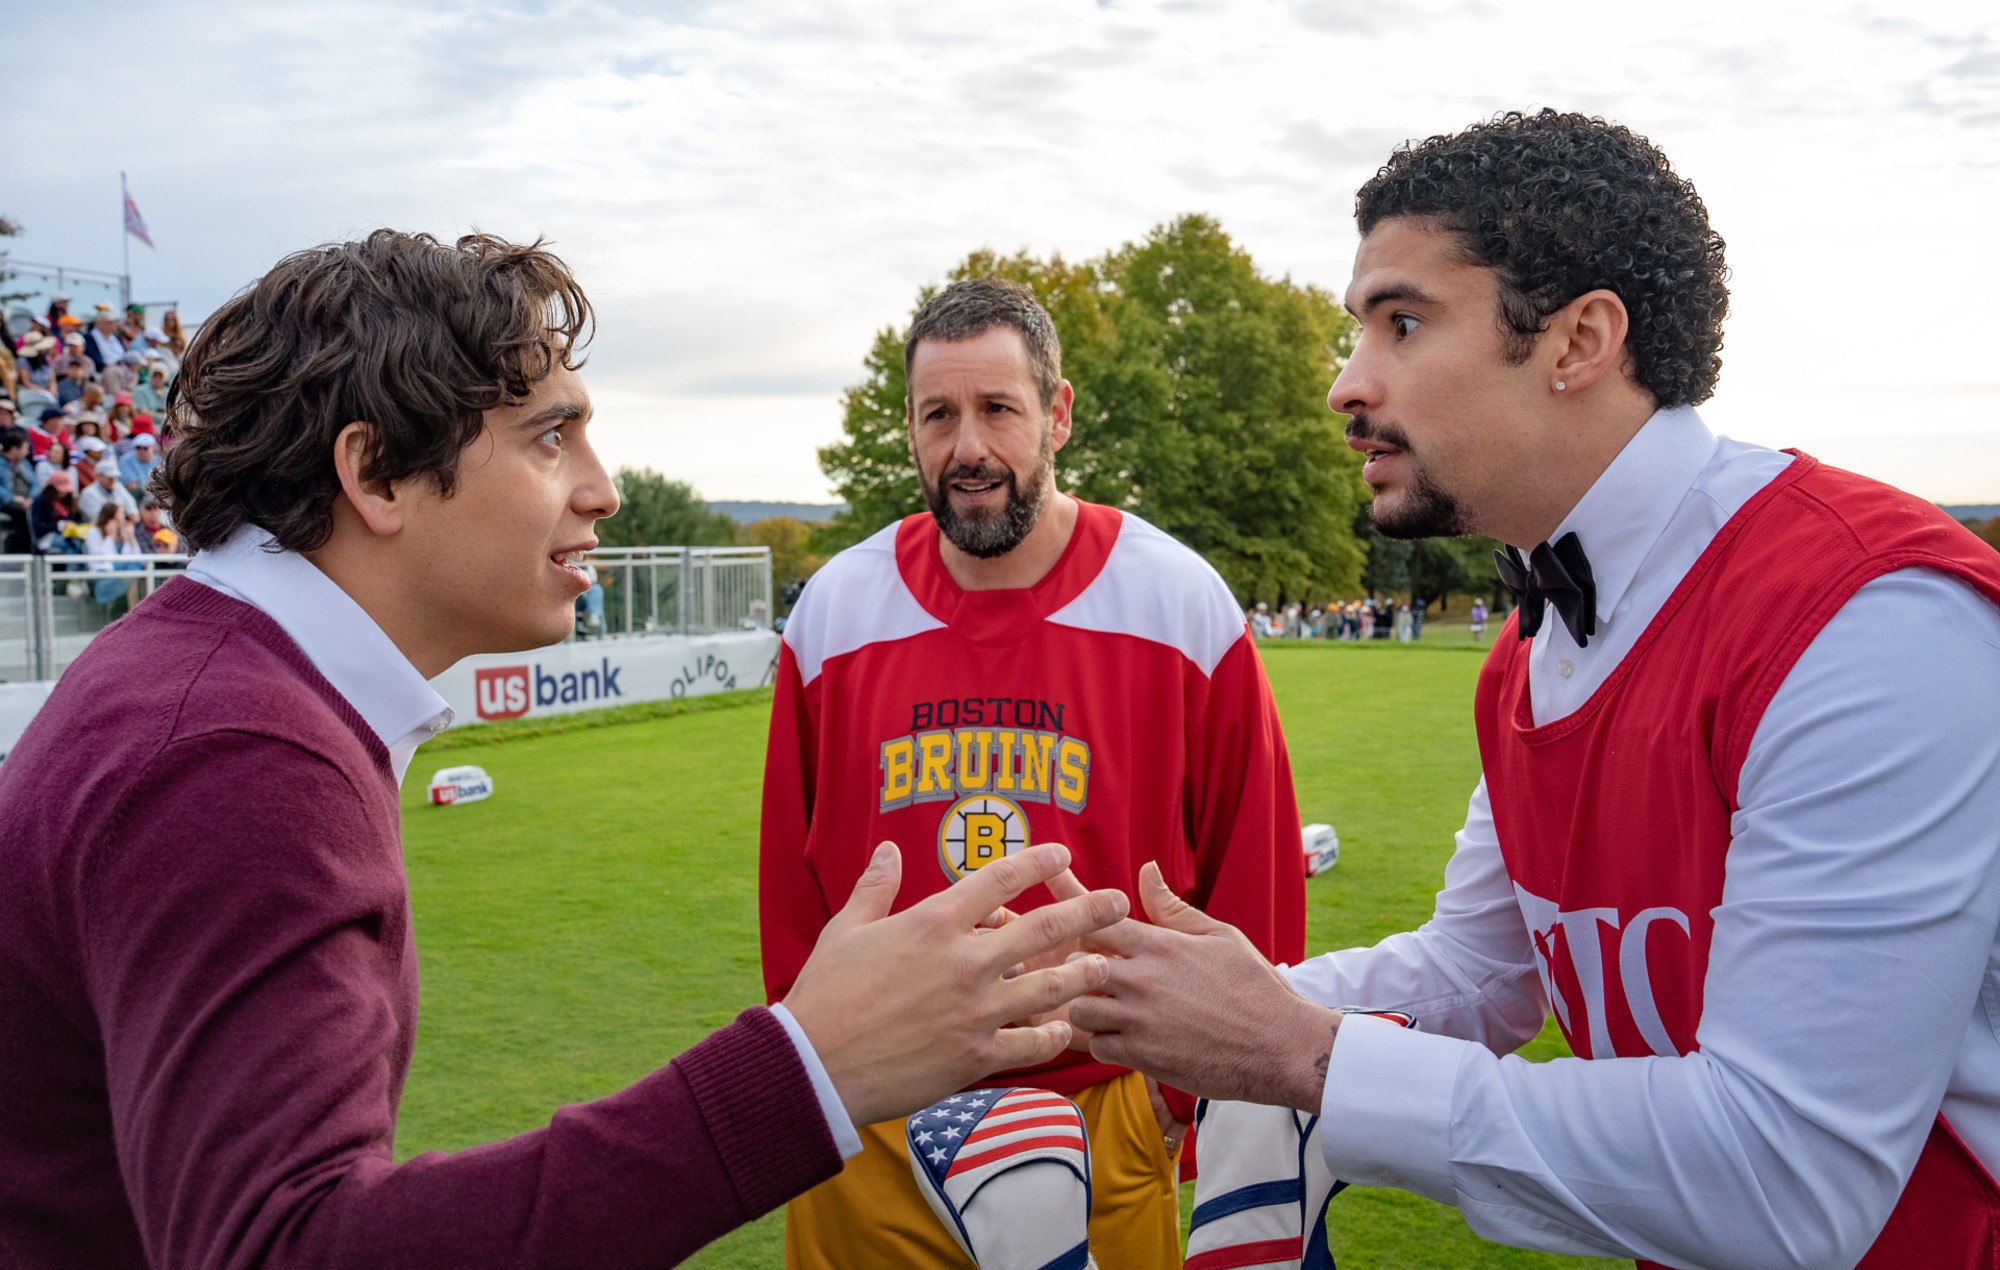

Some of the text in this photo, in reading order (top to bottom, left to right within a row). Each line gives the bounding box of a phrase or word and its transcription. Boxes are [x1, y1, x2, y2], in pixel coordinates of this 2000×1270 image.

[480, 657, 621, 714] us bank
[910, 698, 1064, 731] BOSTON
[458, 781, 488, 798] bank
[879, 728, 1091, 814] BRUINS
[964, 812, 1006, 871] B
